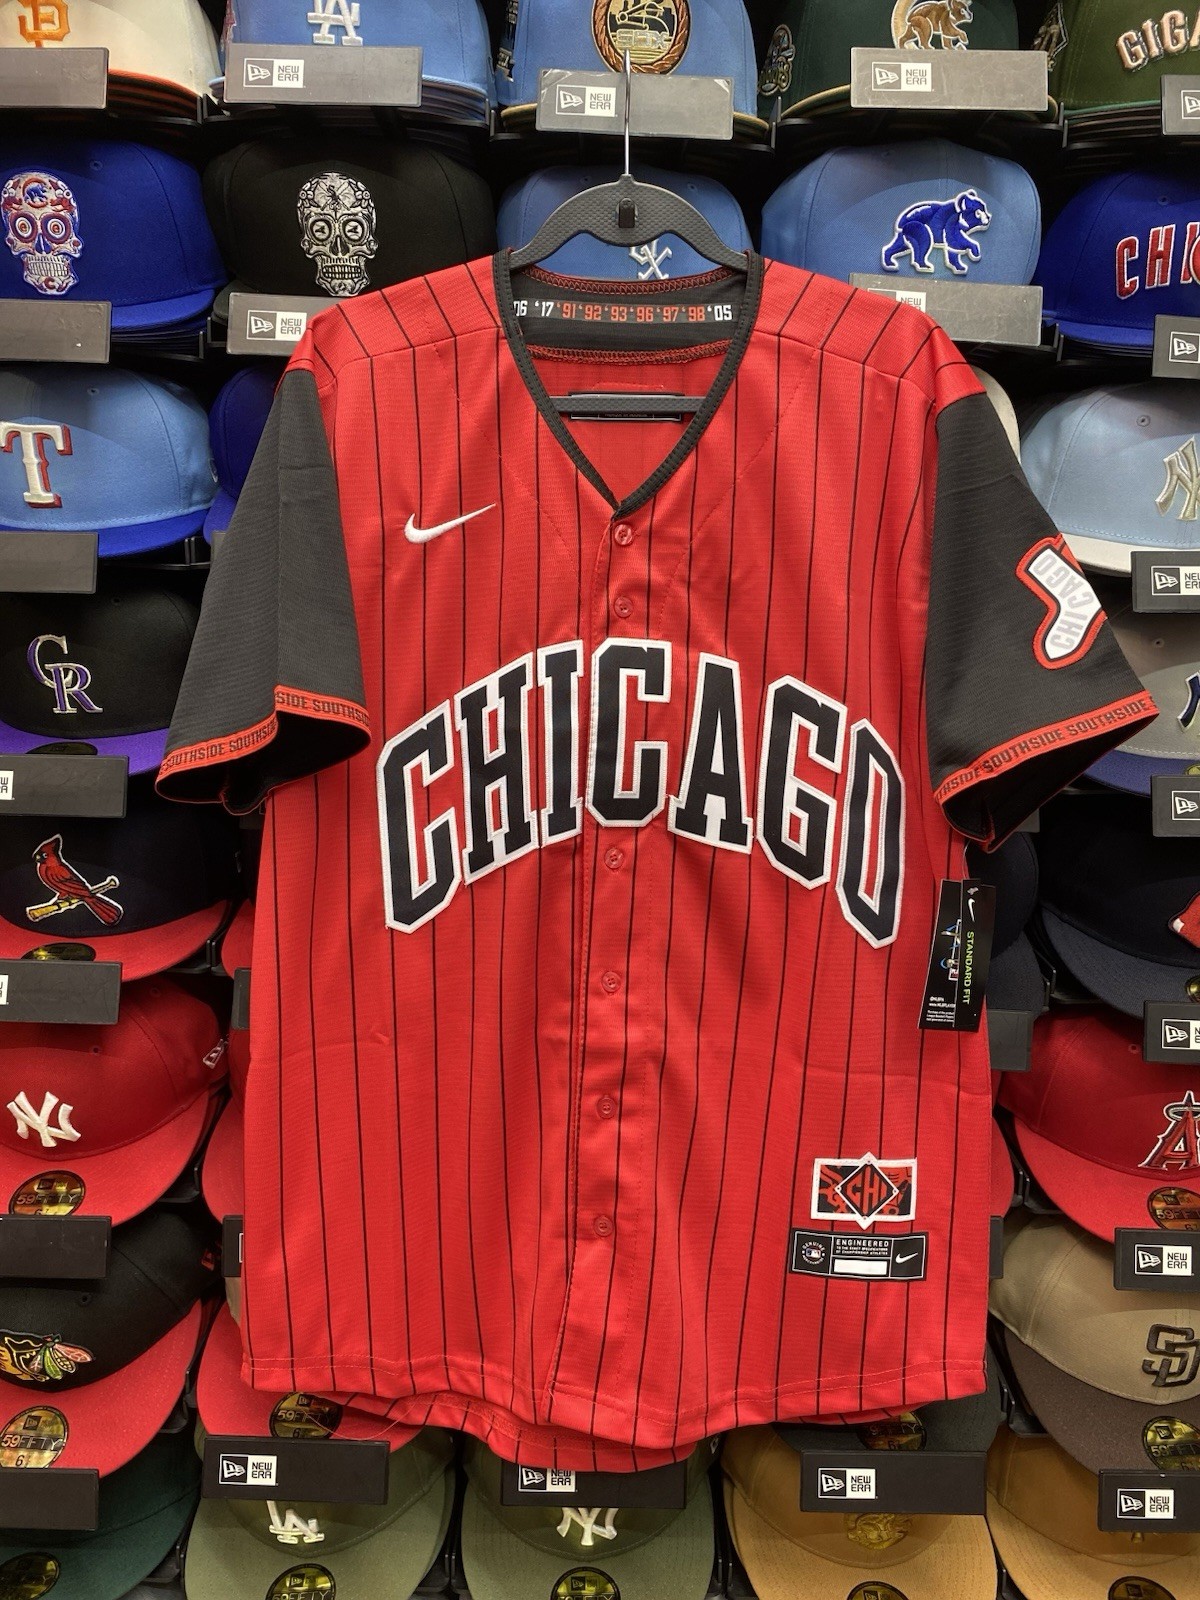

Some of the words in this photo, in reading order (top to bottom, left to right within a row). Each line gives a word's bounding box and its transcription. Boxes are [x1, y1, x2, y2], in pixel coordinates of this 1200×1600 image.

[277, 65, 299, 73] NEW
[905, 69, 927, 77] NEW
[277, 73, 299, 81] ERA
[905, 77, 927, 85] ERA
[589, 93, 611, 101] NEW
[589, 101, 611, 110] ERA
[280, 317, 302, 326] NEW
[280, 325, 301, 335] ERA
[1, 420, 73, 508] T
[1033, 553, 1095, 650] CHICAGO
[27, 634, 103, 714] CR
[1065, 699, 1149, 736] SOUTHSIDE
[982, 729, 1065, 773] SOUTHSIDE
[376, 637, 906, 950] CHICAGO
[963, 931, 975, 987] STANDARD
[962, 988, 971, 1005] FIT
[7, 1091, 81, 1148] NY
[1138, 1090, 1200, 1171] A
[836, 1239, 889, 1247] ENGINEERED
[1167, 1252, 1188, 1261] NEW
[1167, 1261, 1188, 1270] ERA
[1142, 1324, 1200, 1387] SD
[251, 1462, 273, 1471] NEW
[251, 1470, 272, 1479] ERA
[551, 1477, 571, 1486] ERA
[850, 1475, 871, 1484] NEW
[850, 1483, 871, 1492] ERA
[1149, 1496, 1170, 1504] NEW
[1149, 1504, 1170, 1513] ERA
